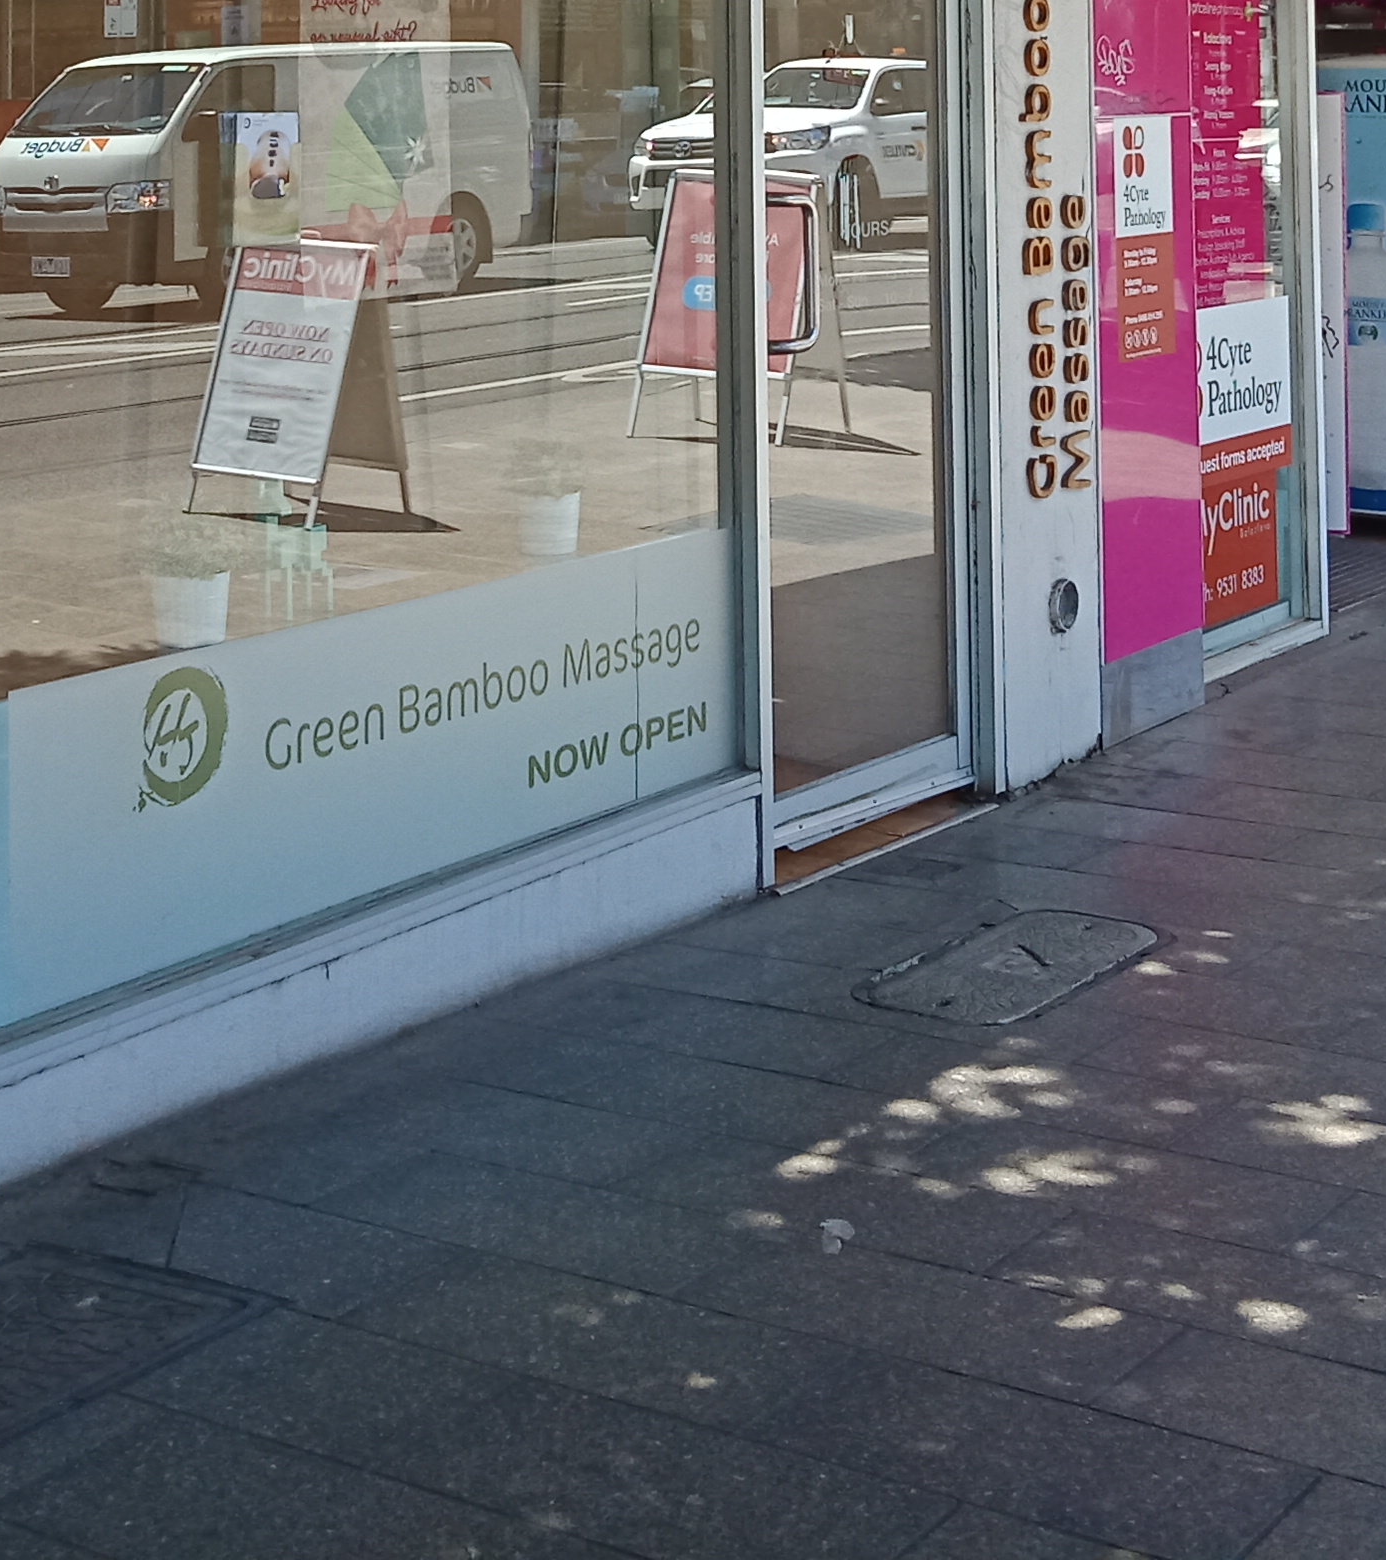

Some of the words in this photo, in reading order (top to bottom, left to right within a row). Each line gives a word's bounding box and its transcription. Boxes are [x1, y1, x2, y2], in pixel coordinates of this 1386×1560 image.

[1123, 184, 1149, 203] 4Cyte
[1124, 207, 1166, 229] Pathology
[1060, 195, 1093, 491] Massage
[1206, 335, 1252, 377] 4Cyte
[1028, 298, 1058, 501] Green
[1207, 376, 1283, 417] Pathology
[1220, 447, 1246, 468] forms
[1246, 436, 1285, 464] accepted
[1216, 573, 1238, 600] 9531
[1241, 564, 1264, 590] 8383
[265, 703, 385, 770] Green
[399, 659, 549, 733] Bamboo
[564, 618, 701, 689] Massage
[528, 731, 609, 789] NOW
[620, 700, 707, 757] OPEN
